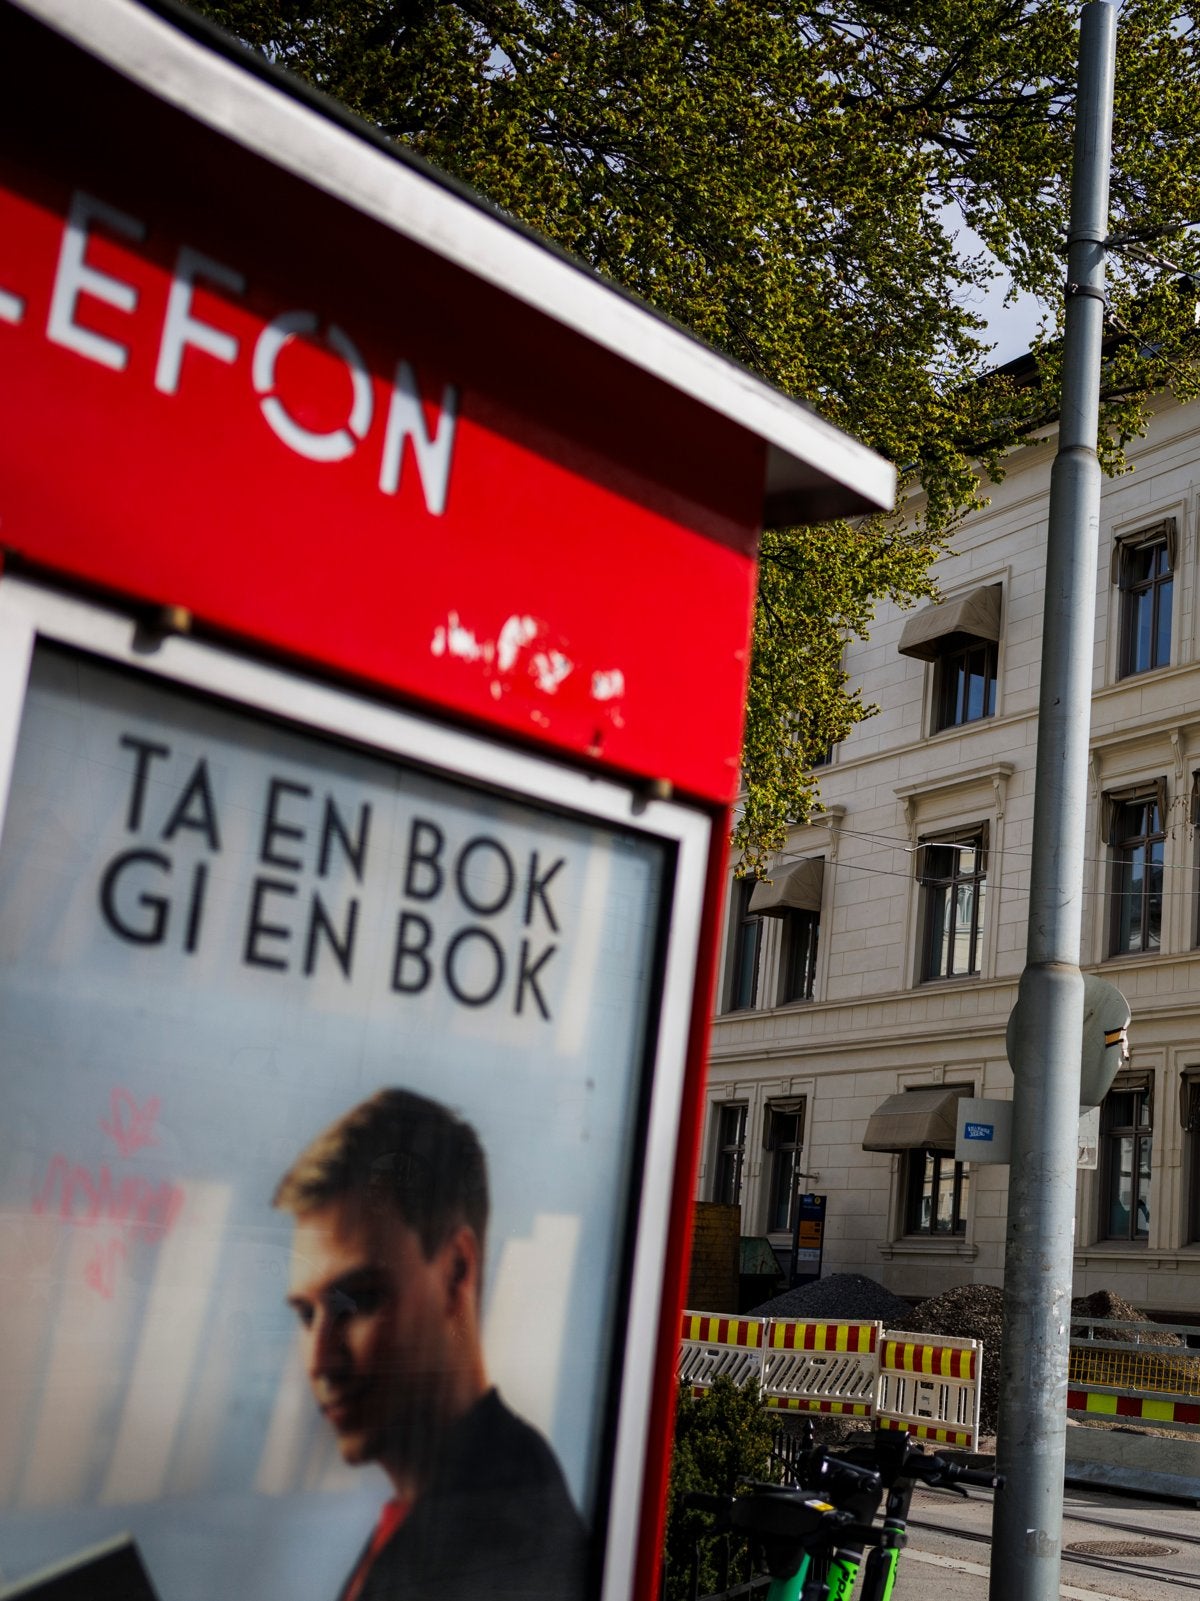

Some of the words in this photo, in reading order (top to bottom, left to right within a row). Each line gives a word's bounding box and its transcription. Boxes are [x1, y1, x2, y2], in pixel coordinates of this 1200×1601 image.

[0, 190, 458, 516] EFON
[120, 735, 221, 852] TA
[260, 777, 372, 886] EN
[404, 817, 566, 934] BOK
[100, 848, 211, 955] GI
[243, 878, 359, 983] EN
[391, 912, 557, 1022] BOK
